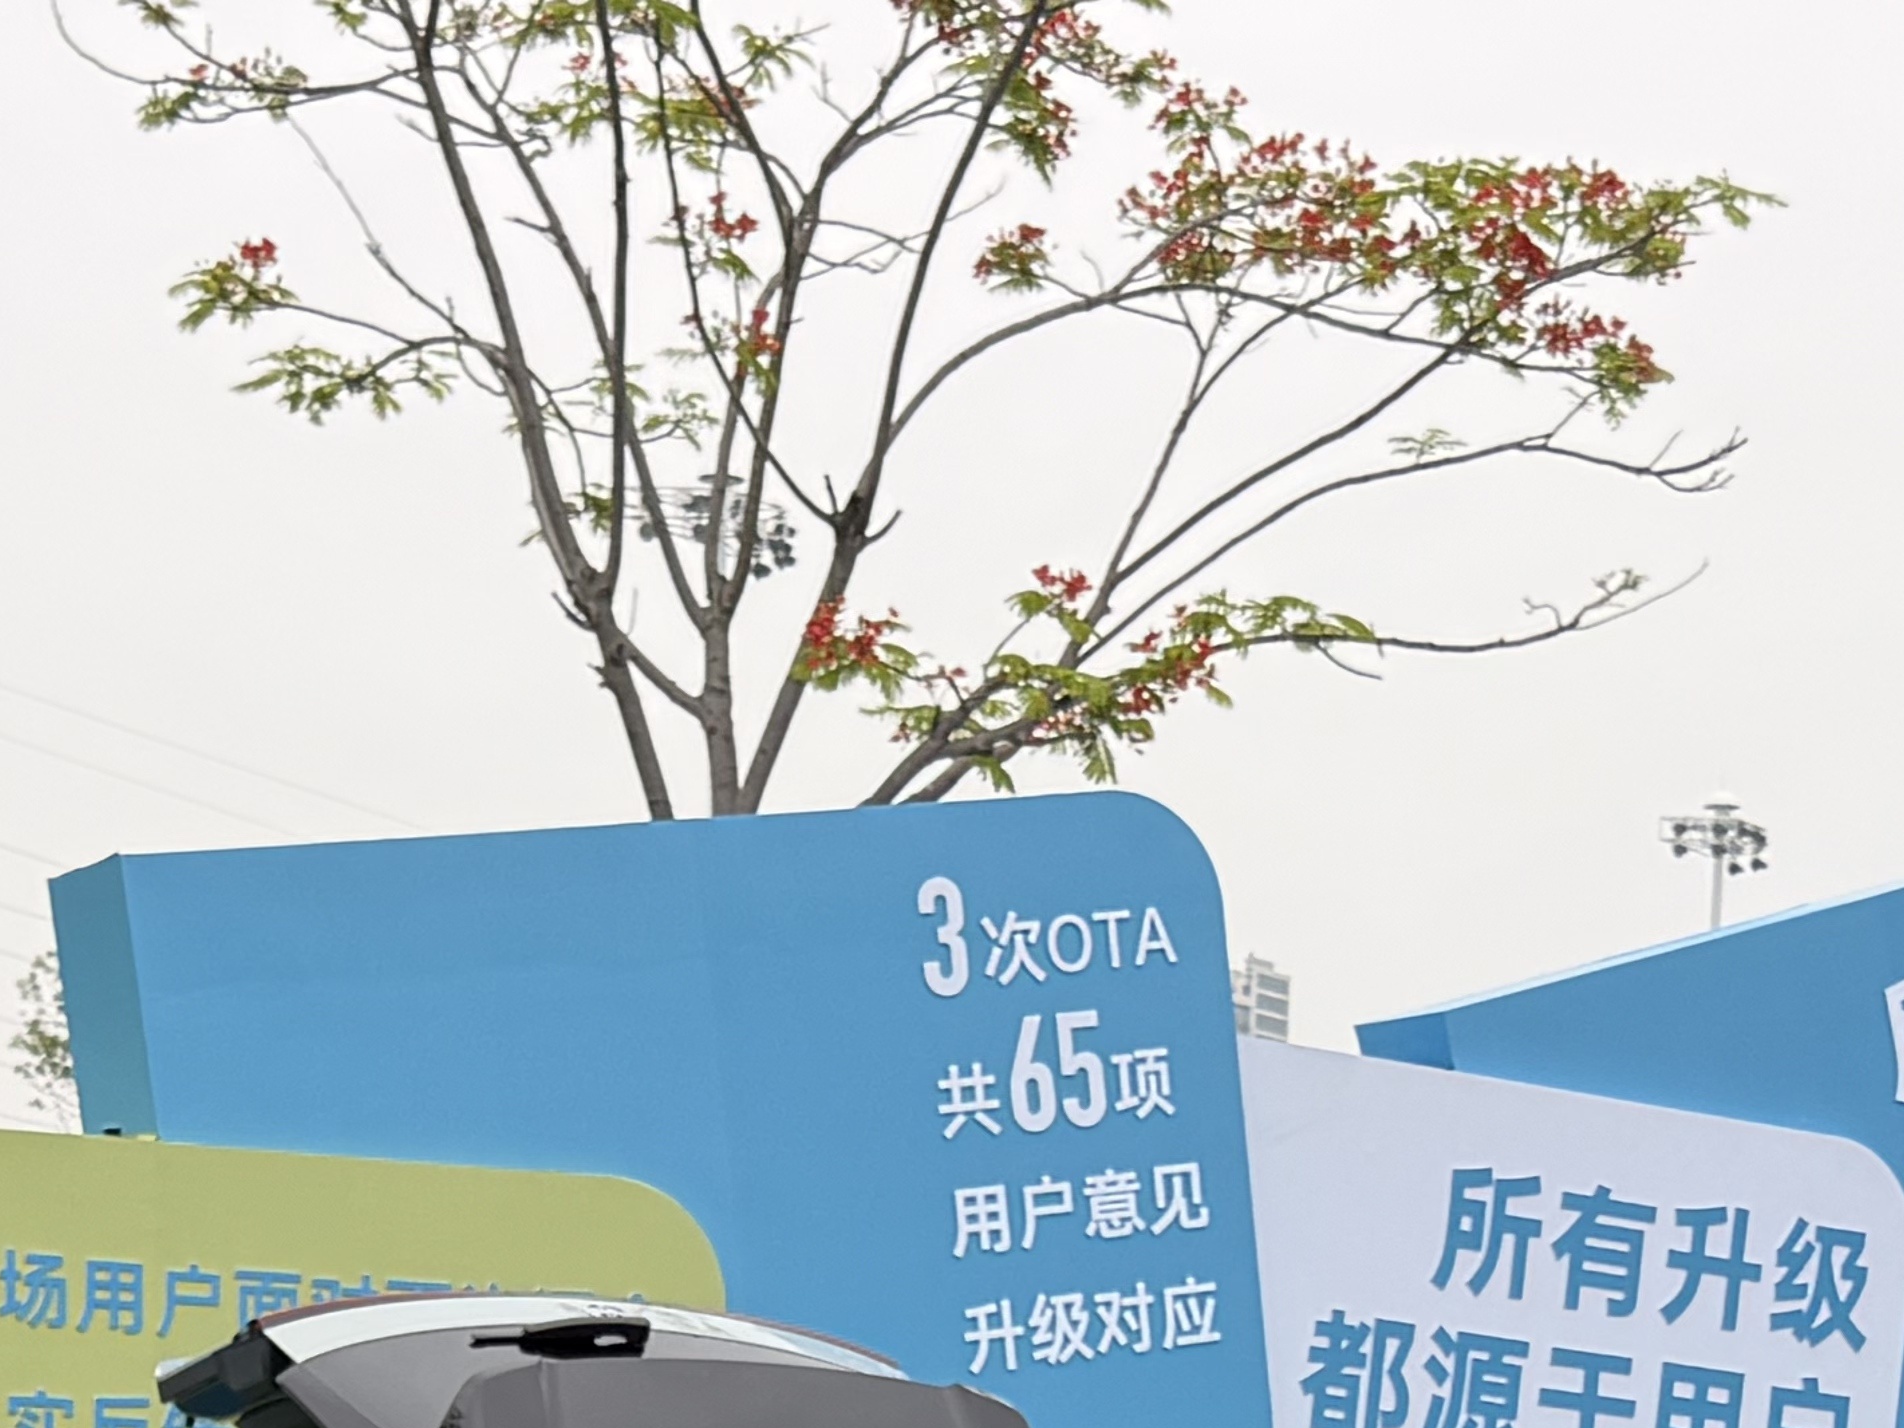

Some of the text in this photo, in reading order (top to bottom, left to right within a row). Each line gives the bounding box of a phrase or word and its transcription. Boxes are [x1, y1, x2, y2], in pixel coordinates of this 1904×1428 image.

[917, 876, 1178, 997] 3次OTA
[937, 1009, 1175, 1139] 共65项
[952, 1161, 1210, 1258] 用户意见
[1432, 1167, 1869, 1355] 所有升级
[963, 1277, 1221, 1375] 升级对应
